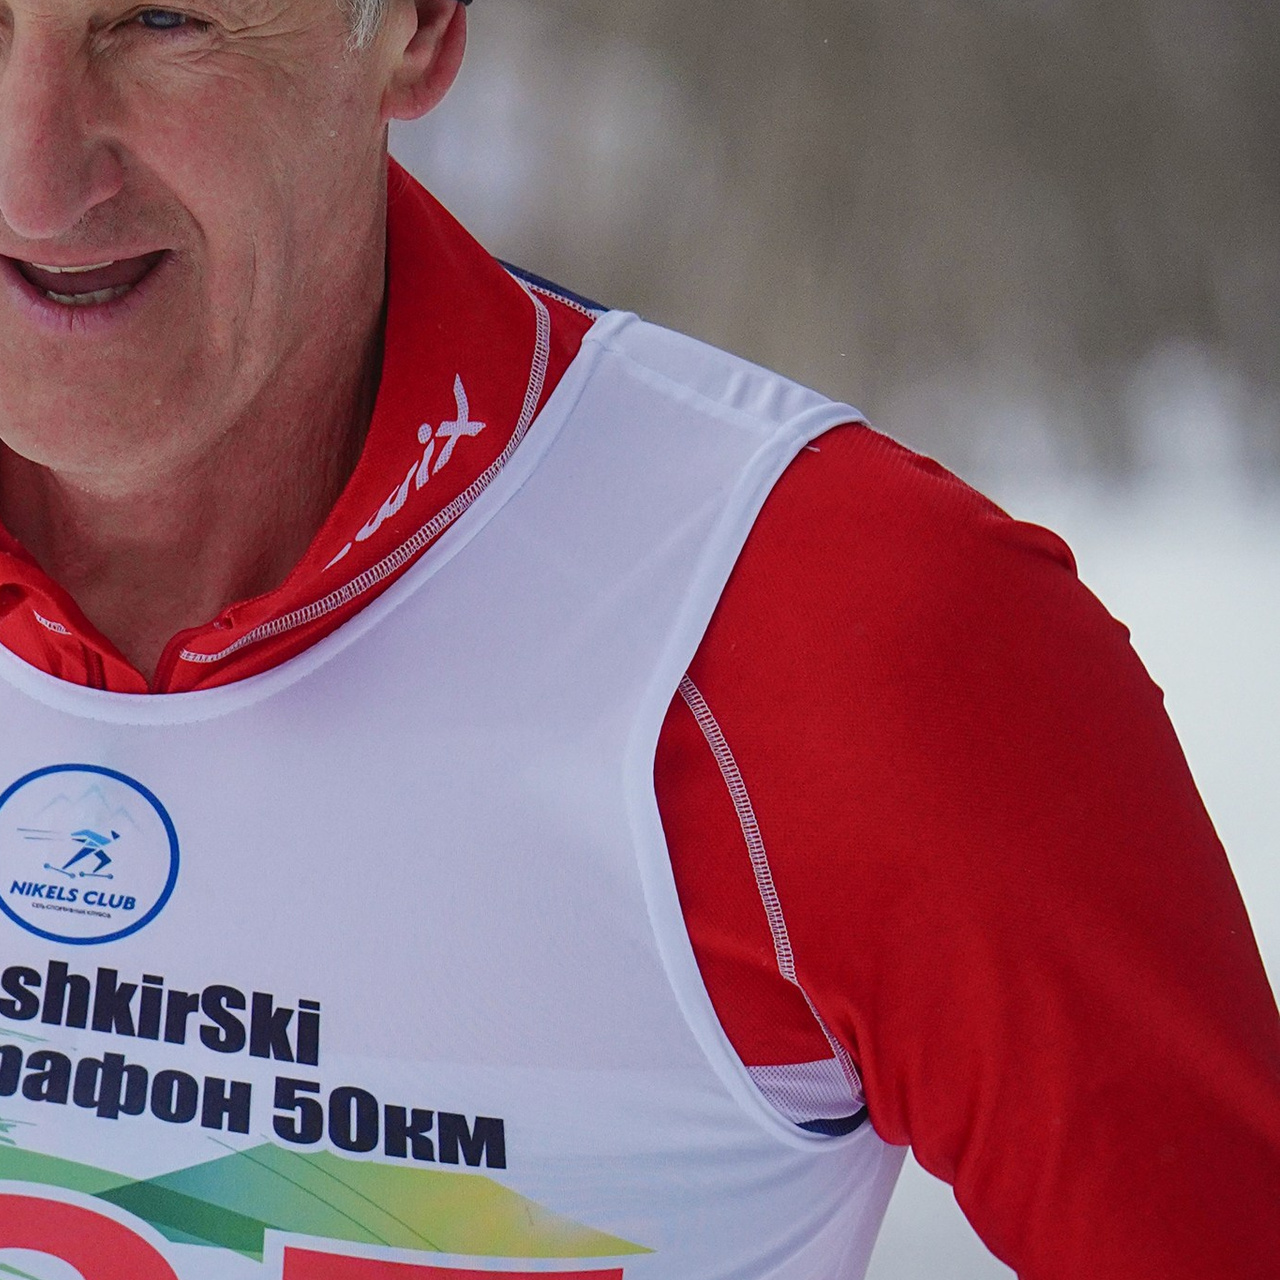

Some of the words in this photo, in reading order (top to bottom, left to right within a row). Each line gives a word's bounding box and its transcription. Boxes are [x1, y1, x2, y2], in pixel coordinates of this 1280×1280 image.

[9, 880, 79, 903] NIKELS
[83, 890, 137, 910] CLUB
[272, 1075, 508, 1170] 50км
